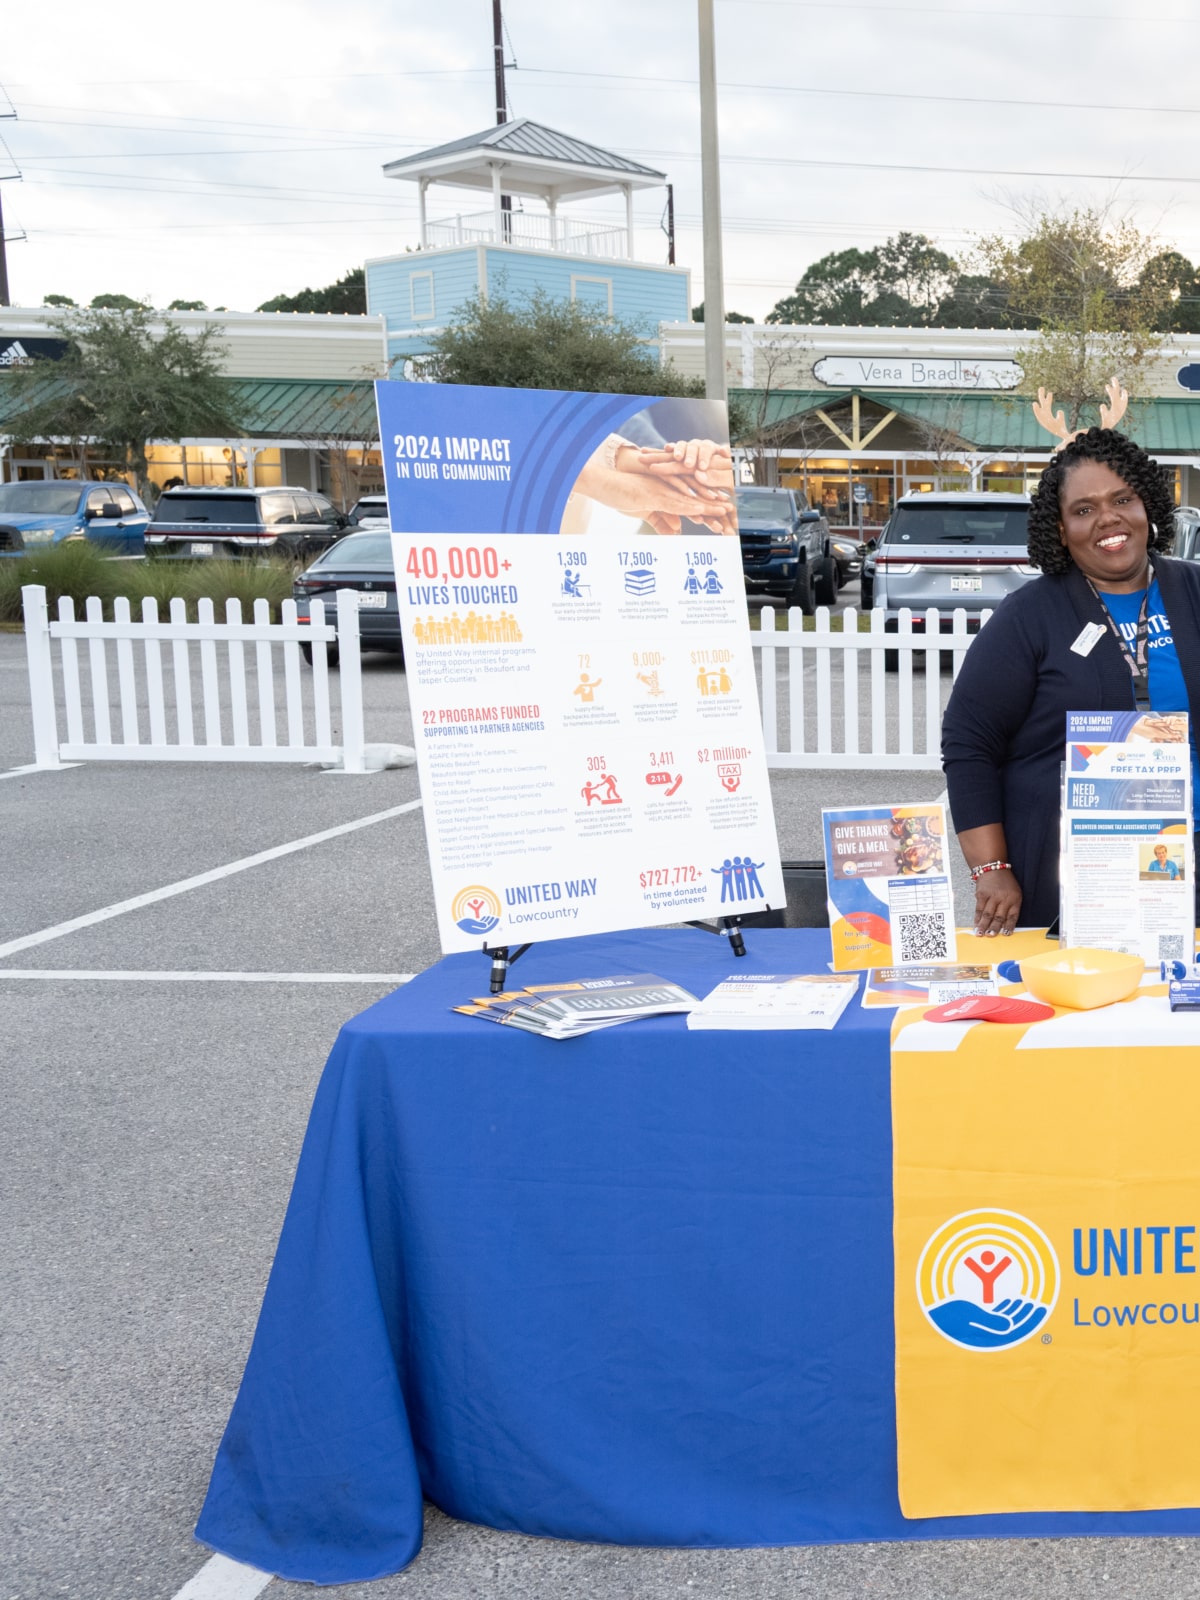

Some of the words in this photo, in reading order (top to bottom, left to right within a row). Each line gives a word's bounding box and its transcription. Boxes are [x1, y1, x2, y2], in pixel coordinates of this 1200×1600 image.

[858, 361, 902, 381] Vera
[911, 361, 982, 386] Bradley
[393, 434, 441, 459] 2024
[445, 436, 512, 461] IMPACT
[395, 462, 410, 478] IN
[413, 462, 438, 479] OUR
[441, 463, 512, 481] COMMUNITY
[403, 546, 514, 584] 40,000+
[557, 551, 587, 567] 1,390
[617, 551, 658, 566] 17,500+
[685, 551, 718, 566] 1,500+
[407, 585, 450, 605] LIVES
[451, 585, 518, 604] TOUCHED
[415, 651, 425, 659] by
[454, 649, 470, 657] Way
[501, 648, 536, 656] programs
[415, 657, 446, 667] offering
[448, 656, 496, 666] opportunities
[498, 655, 508, 663] for
[577, 653, 591, 669] 72
[632, 650, 667, 666] 9,000+
[516, 664, 530, 672] and
[422, 710, 436, 724] 22
[438, 706, 498, 723] PROGRAMS
[500, 704, 540, 720] FUNDED
[1070, 716, 1088, 725] 2024
[1088, 716, 1113, 726] IMPACT
[423, 725, 469, 737] SUPPORTING
[469, 725, 478, 734] 14
[479, 722, 510, 734] PARTNER
[511, 720, 545, 732] AGENCIES
[649, 750, 674, 768] 3,411
[697, 748, 710, 763] $2
[712, 745, 752, 761] million+
[586, 755, 606, 771] 305
[720, 766, 738, 774] TAX
[1072, 783, 1096, 796] NEED
[1072, 796, 1100, 807] HELP?
[835, 827, 856, 839] GIVE
[856, 824, 889, 838] THANKS
[837, 842, 857, 855] GIVE
[858, 842, 865, 853] A
[866, 841, 889, 853] MEAL
[638, 864, 703, 889] $727,772+
[505, 882, 562, 906] UNITED
[564, 877, 598, 898] WAY
[643, 891, 652, 900] in
[652, 889, 672, 899] time
[673, 885, 707, 896] donated
[650, 900, 661, 910] by
[662, 894, 704, 907] volunteers
[508, 905, 579, 926] Lowcountry
